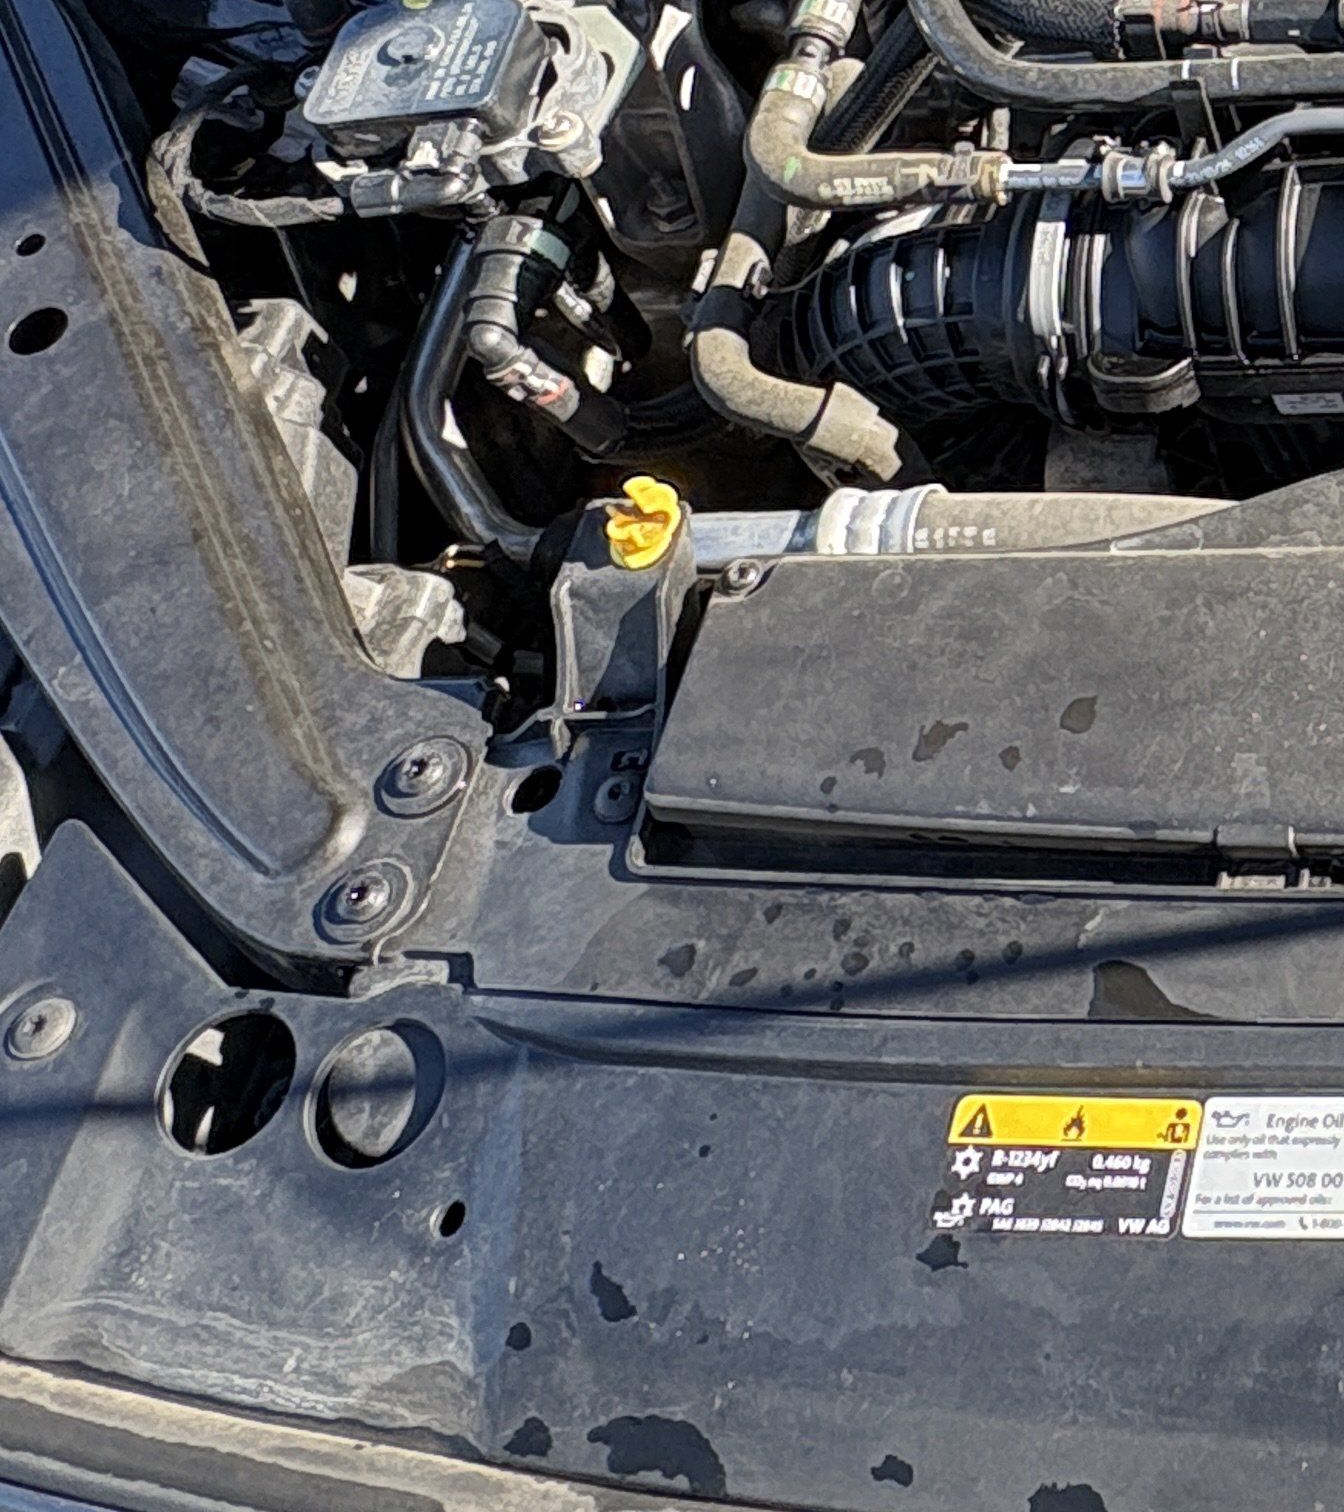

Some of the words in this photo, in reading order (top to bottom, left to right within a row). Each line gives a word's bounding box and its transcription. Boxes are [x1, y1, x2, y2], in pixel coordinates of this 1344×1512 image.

[1266, 1113, 1319, 1133] Engine
[1322, 1113, 1344, 1129] Oil
[990, 1149, 1061, 1173] R-1234yf
[1133, 1155, 1152, 1175] kg
[1253, 1172, 1284, 1188] VW
[1285, 1172, 1318, 1189] 508
[1321, 1172, 1344, 1188] 00
[978, 1198, 1016, 1216] PAG
[1118, 1218, 1146, 1234] VW
[1145, 1218, 1172, 1235] AG
